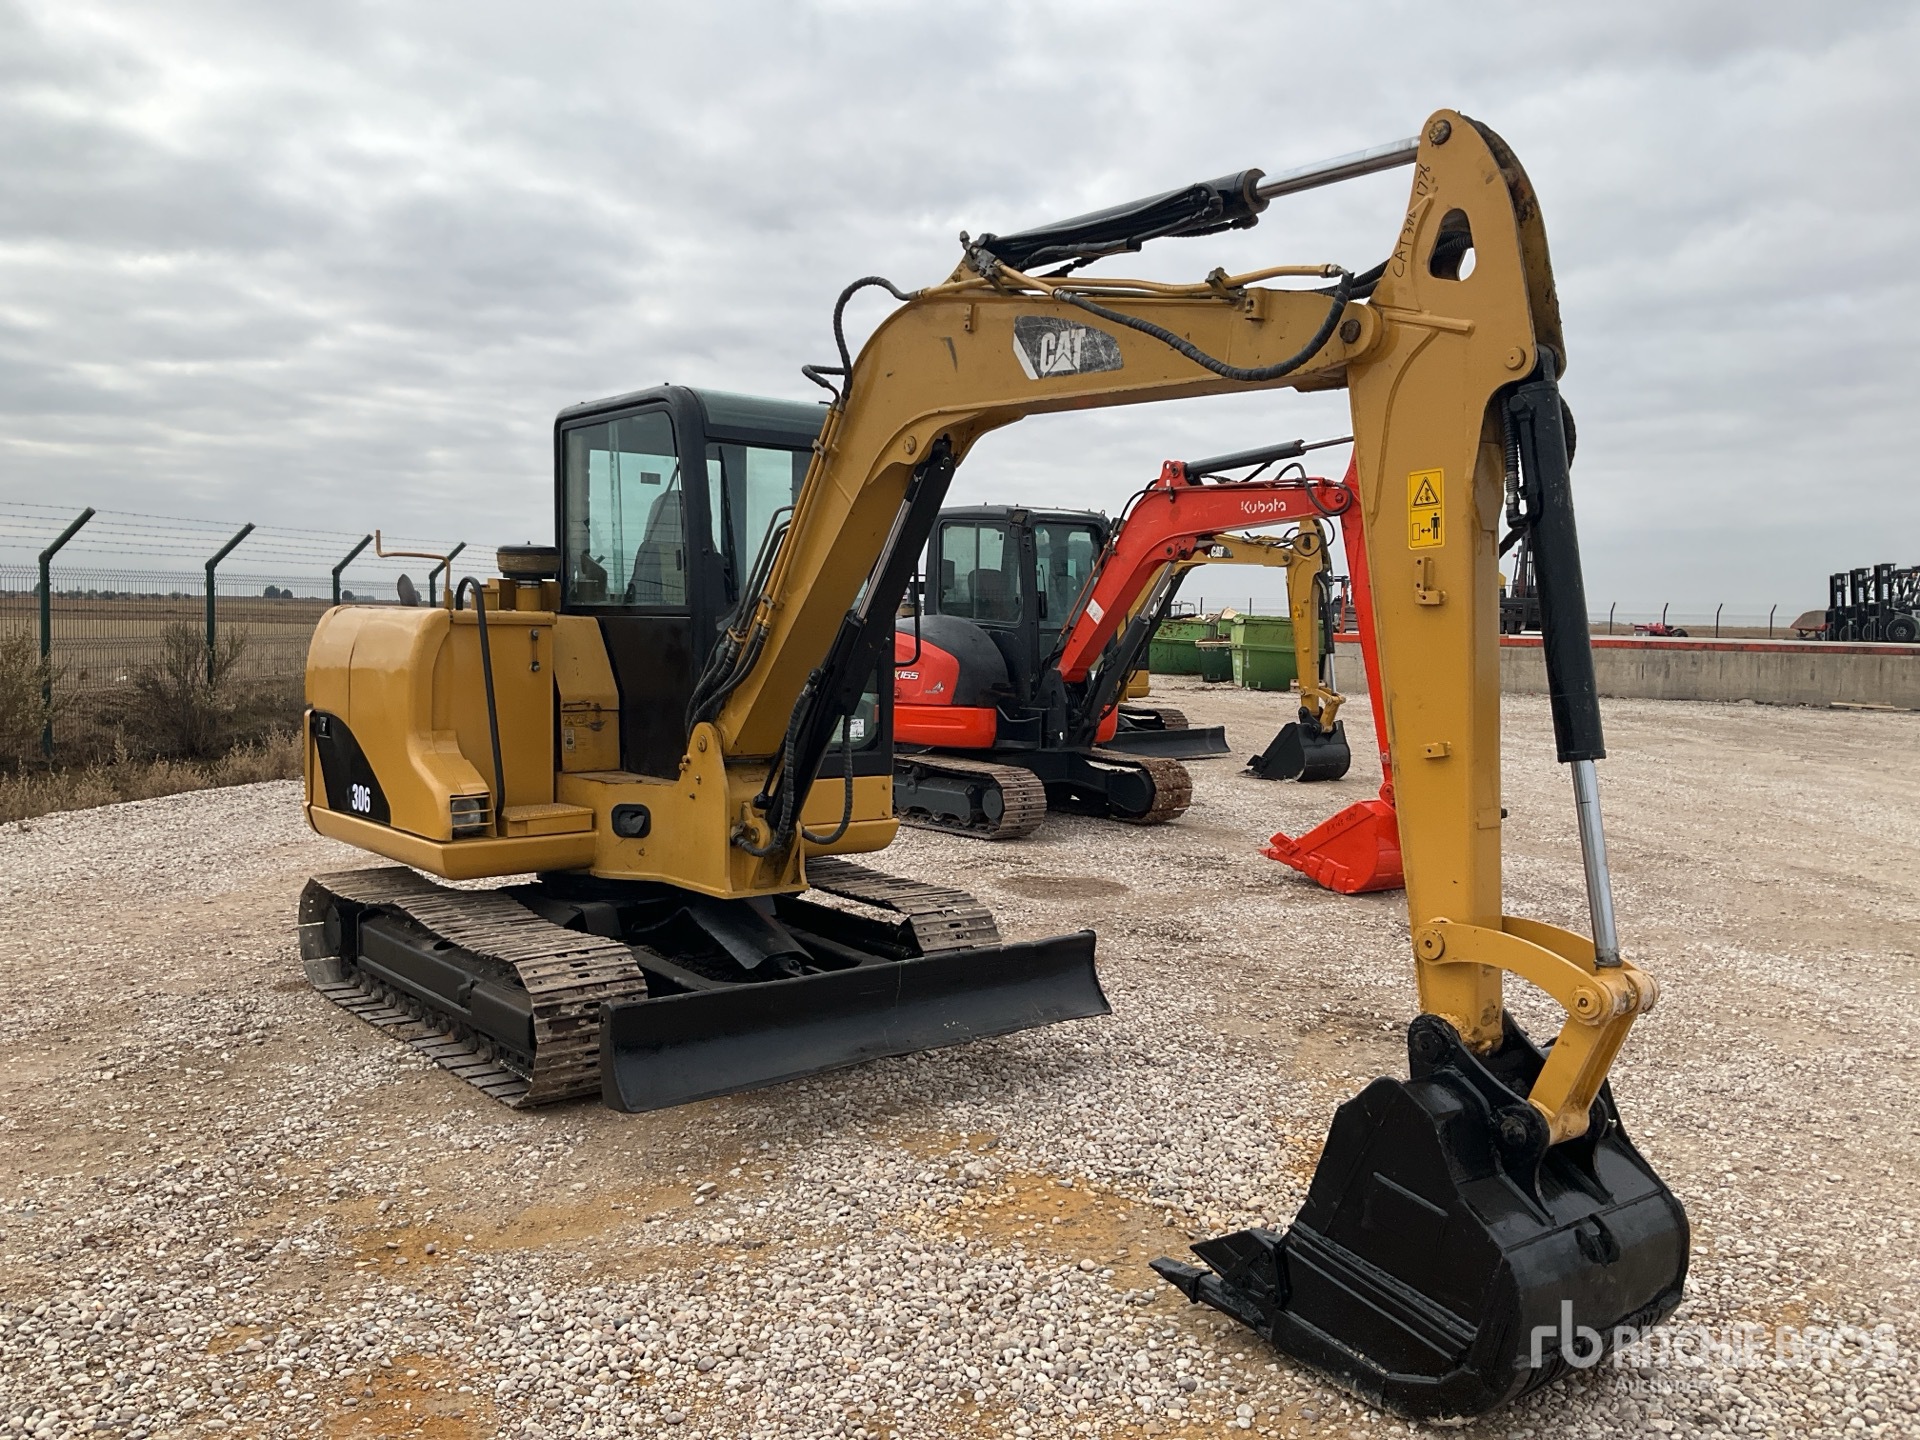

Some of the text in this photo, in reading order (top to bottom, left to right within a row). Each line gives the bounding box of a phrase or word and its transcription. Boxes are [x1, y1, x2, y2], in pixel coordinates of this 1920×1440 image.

[1040, 328, 1087, 373] CAT
[1240, 498, 1287, 514] Kubota
[1210, 546, 1225, 559] CAT
[351, 783, 371, 813] 306
